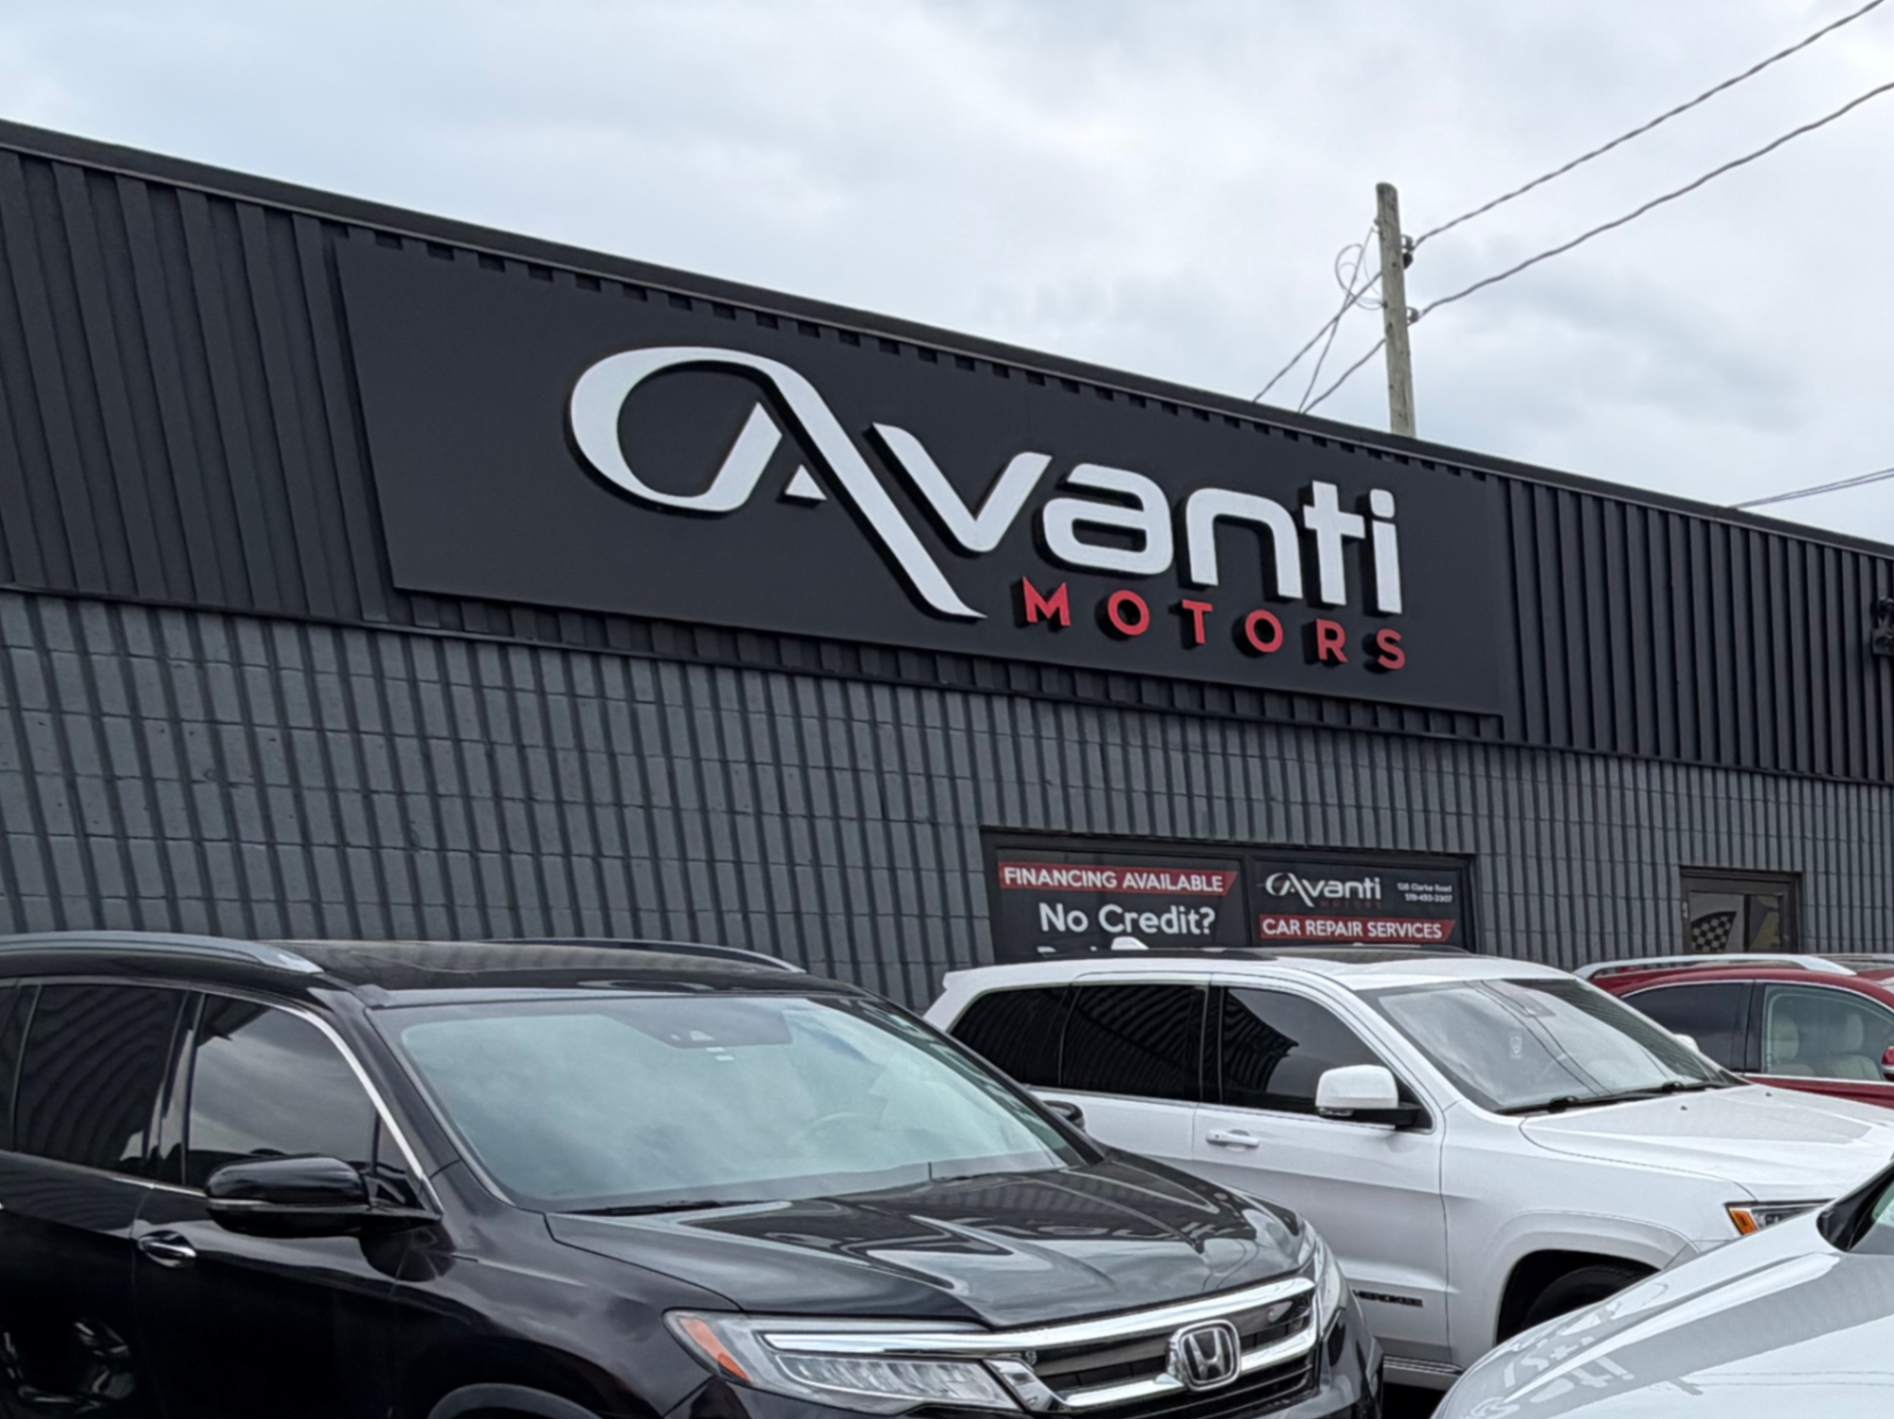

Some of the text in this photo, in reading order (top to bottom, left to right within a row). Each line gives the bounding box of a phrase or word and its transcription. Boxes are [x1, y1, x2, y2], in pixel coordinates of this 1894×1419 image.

[569, 347, 1402, 618] Avanti
[1020, 577, 1406, 670] MOTORS
[1003, 867, 1223, 893] FINANCING AVAILABLE
[1265, 872, 1381, 908] Avanti
[1039, 903, 1216, 935] No Credit?
[1262, 918, 1443, 939] CAR REPAIR SERVICES
